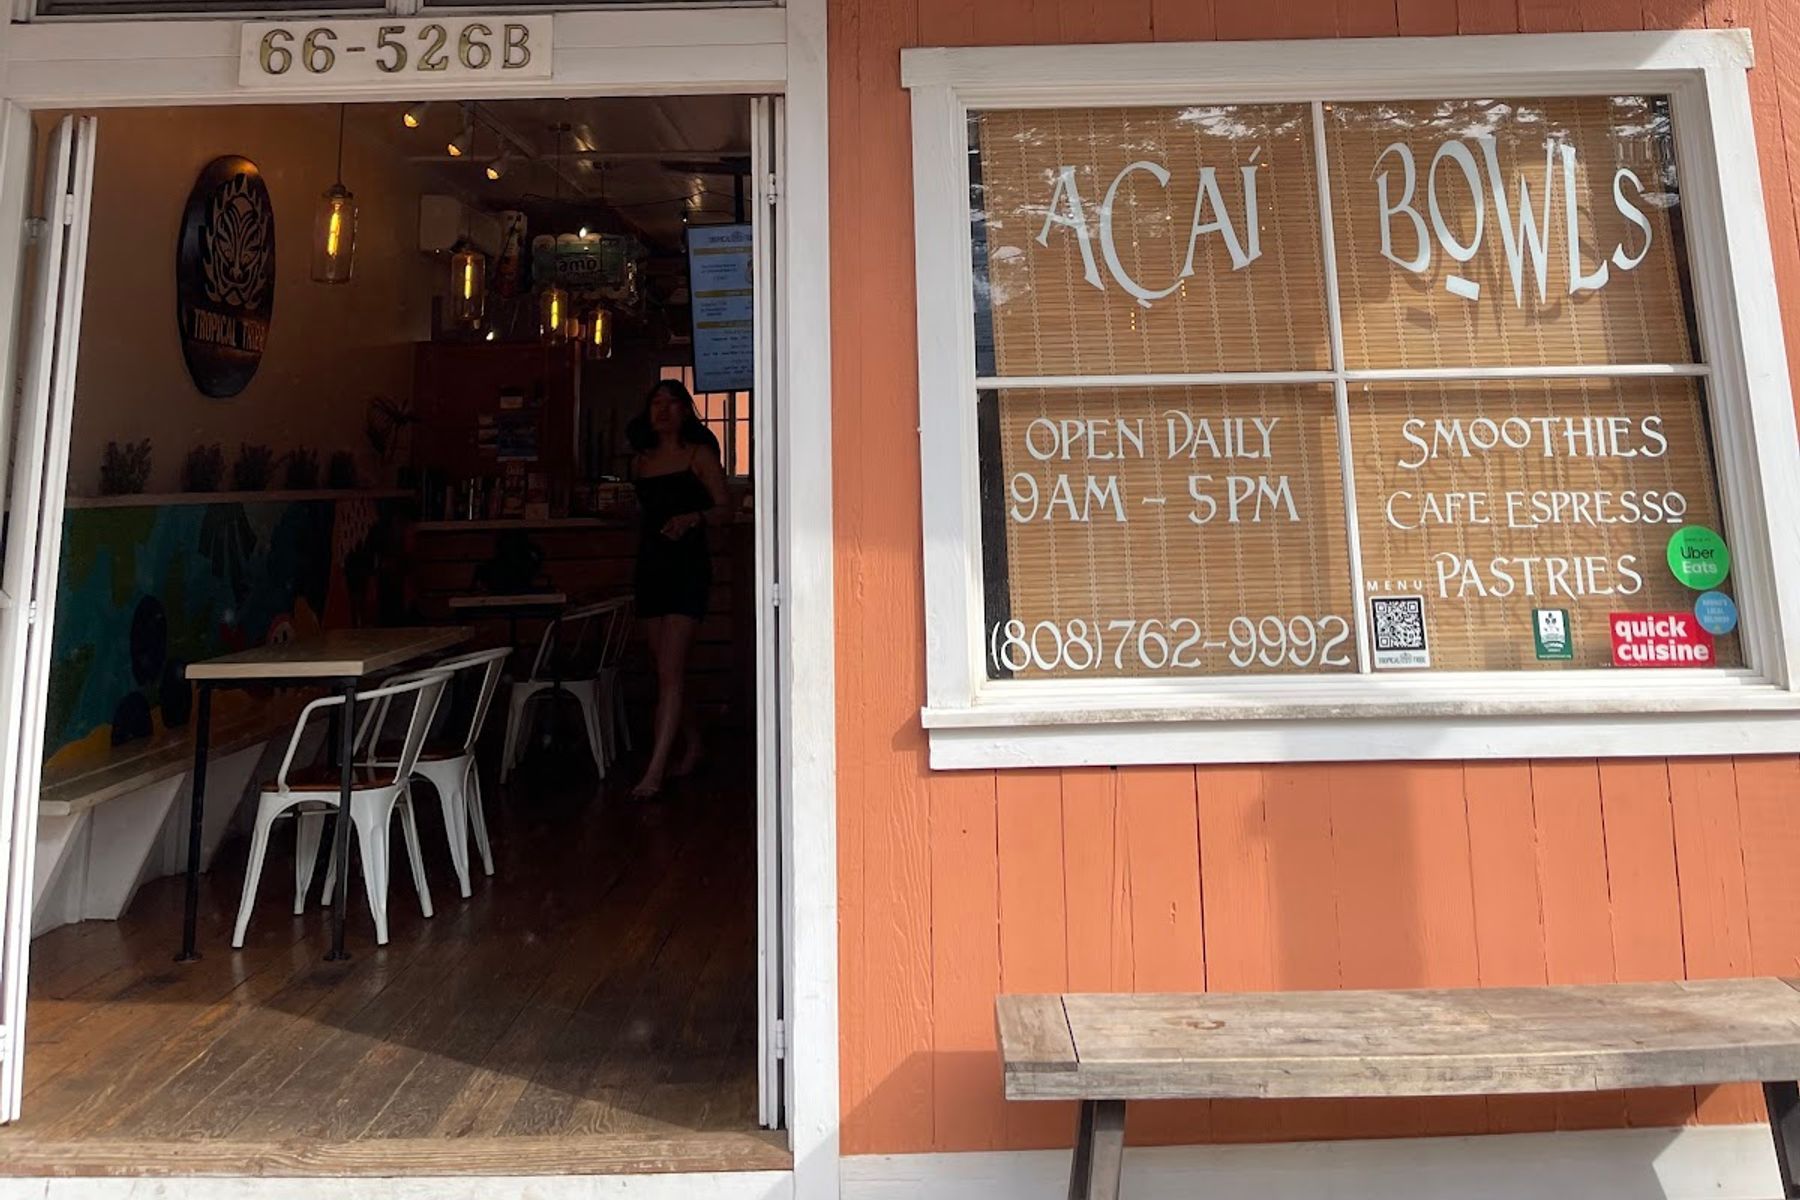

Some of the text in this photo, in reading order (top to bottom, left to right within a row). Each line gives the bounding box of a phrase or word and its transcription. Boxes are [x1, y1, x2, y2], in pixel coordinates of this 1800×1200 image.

[258, 22, 531, 75] 66-526B
[1370, 137, 1653, 309] BOWLS
[193, 307, 237, 347] TROPICAL
[1025, 409, 1281, 461] OPEN DAILY
[1397, 414, 1668, 470] SMOOTHIES
[1010, 472, 1127, 524] 9AM
[1187, 473, 1300, 525] 5PM
[1386, 490, 1688, 530] CAFE ESPRESSO
[1680, 545, 1715, 560] Uber
[1681, 561, 1718, 575] Eats
[1366, 579, 1424, 592] MENU
[1432, 551, 1643, 601] PASTRIES
[1614, 615, 1688, 642] quick
[1617, 639, 1710, 662] cuisine
